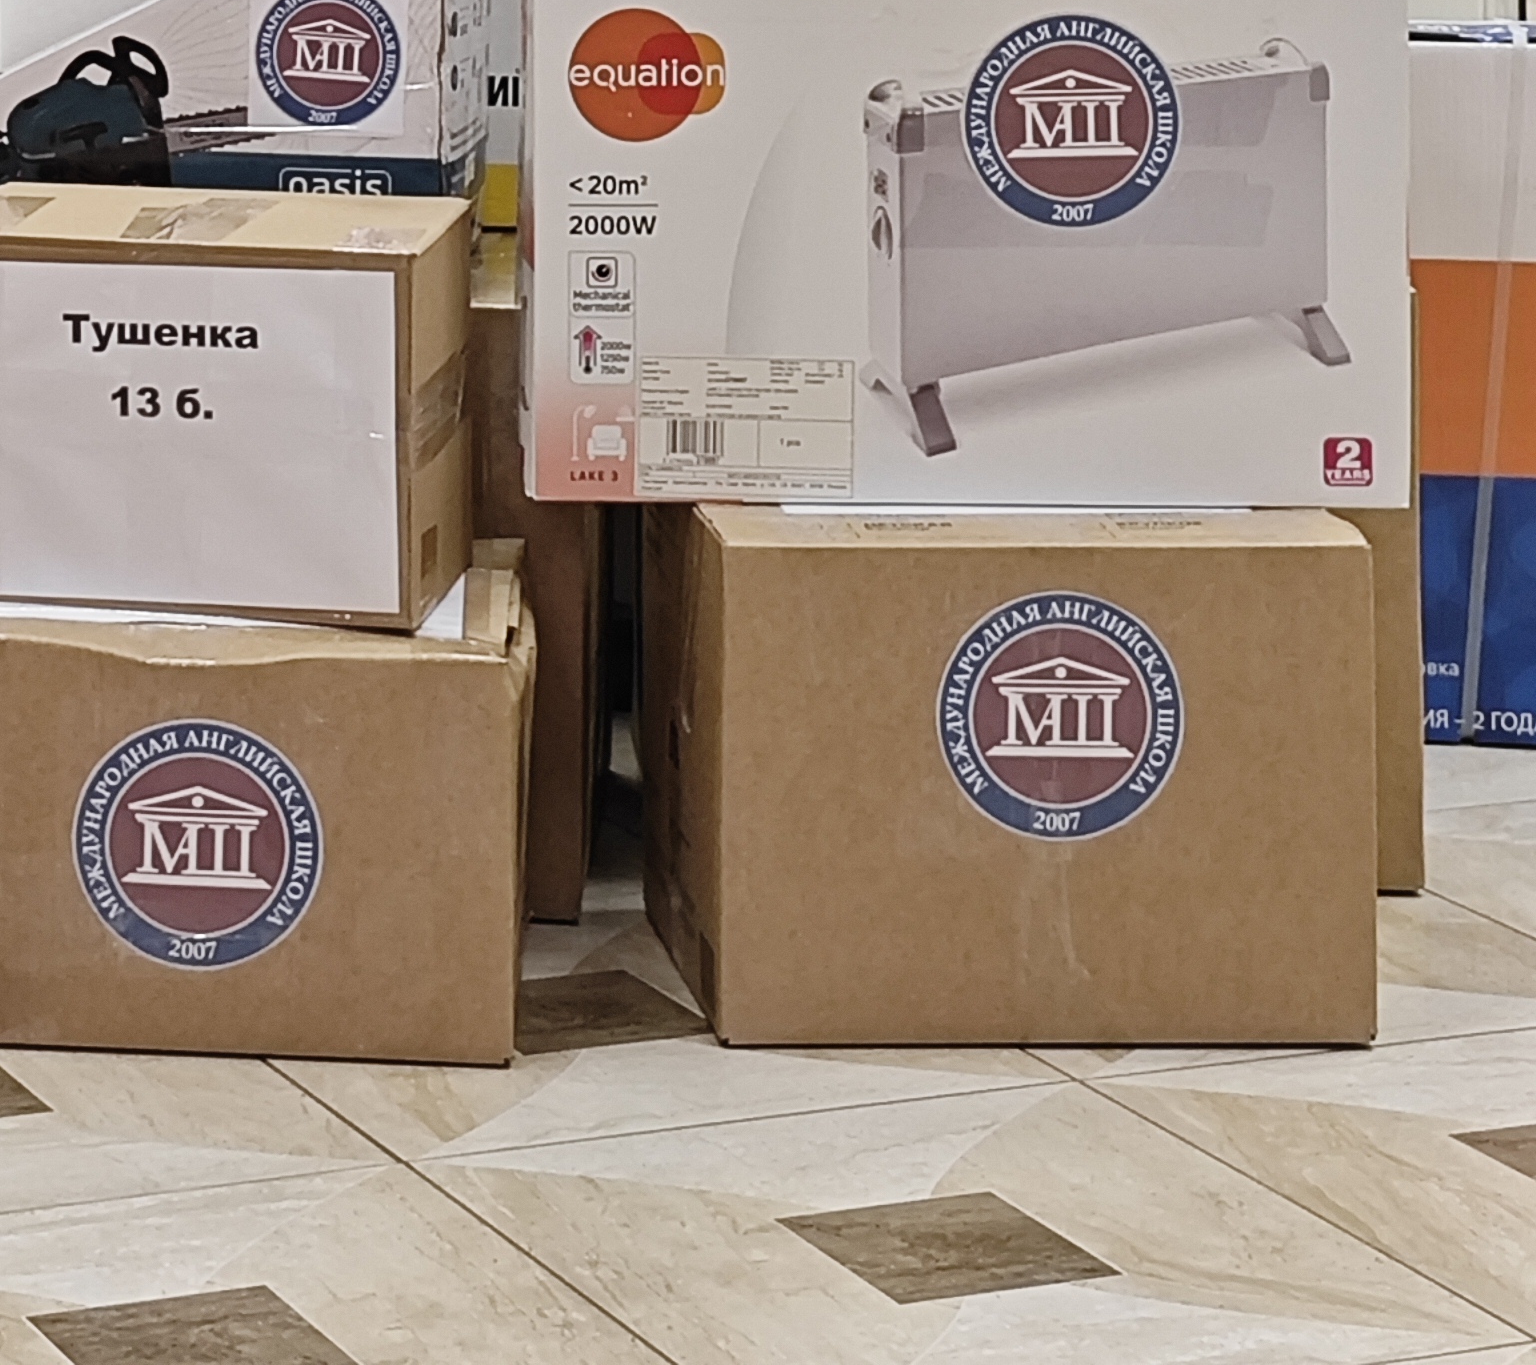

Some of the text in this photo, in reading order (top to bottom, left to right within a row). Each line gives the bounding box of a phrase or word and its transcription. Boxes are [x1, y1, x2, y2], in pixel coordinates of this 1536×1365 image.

[569, 58, 725, 92] equation
[970, 20, 1174, 192] МЕЖДУНАРОДНАЯ АНГЛИЙСКАЯ ШКОЛА
[289, 169, 382, 195] oasis
[569, 215, 657, 235] 2000W
[1051, 203, 1094, 222] 2007
[572, 289, 631, 301] Mechanical
[572, 302, 632, 312] thermostat
[62, 313, 260, 352] Тушенка
[110, 386, 214, 420] 13 б.
[1336, 439, 1361, 468] 2
[570, 470, 605, 481] LAKE
[1325, 469, 1371, 481] YEARS
[946, 600, 1175, 795] МЕЖДУНАРОДНАЯ АНГЛИЙСКАЯ ШКОЛА
[1491, 711, 1536, 736] ГОД
[82, 729, 313, 926] МЕЖДУНАРОДНАЯ АНГЛИЙСКАЯ ШКОЛА
[1032, 811, 1081, 831] 2007
[168, 939, 217, 960] 2007
